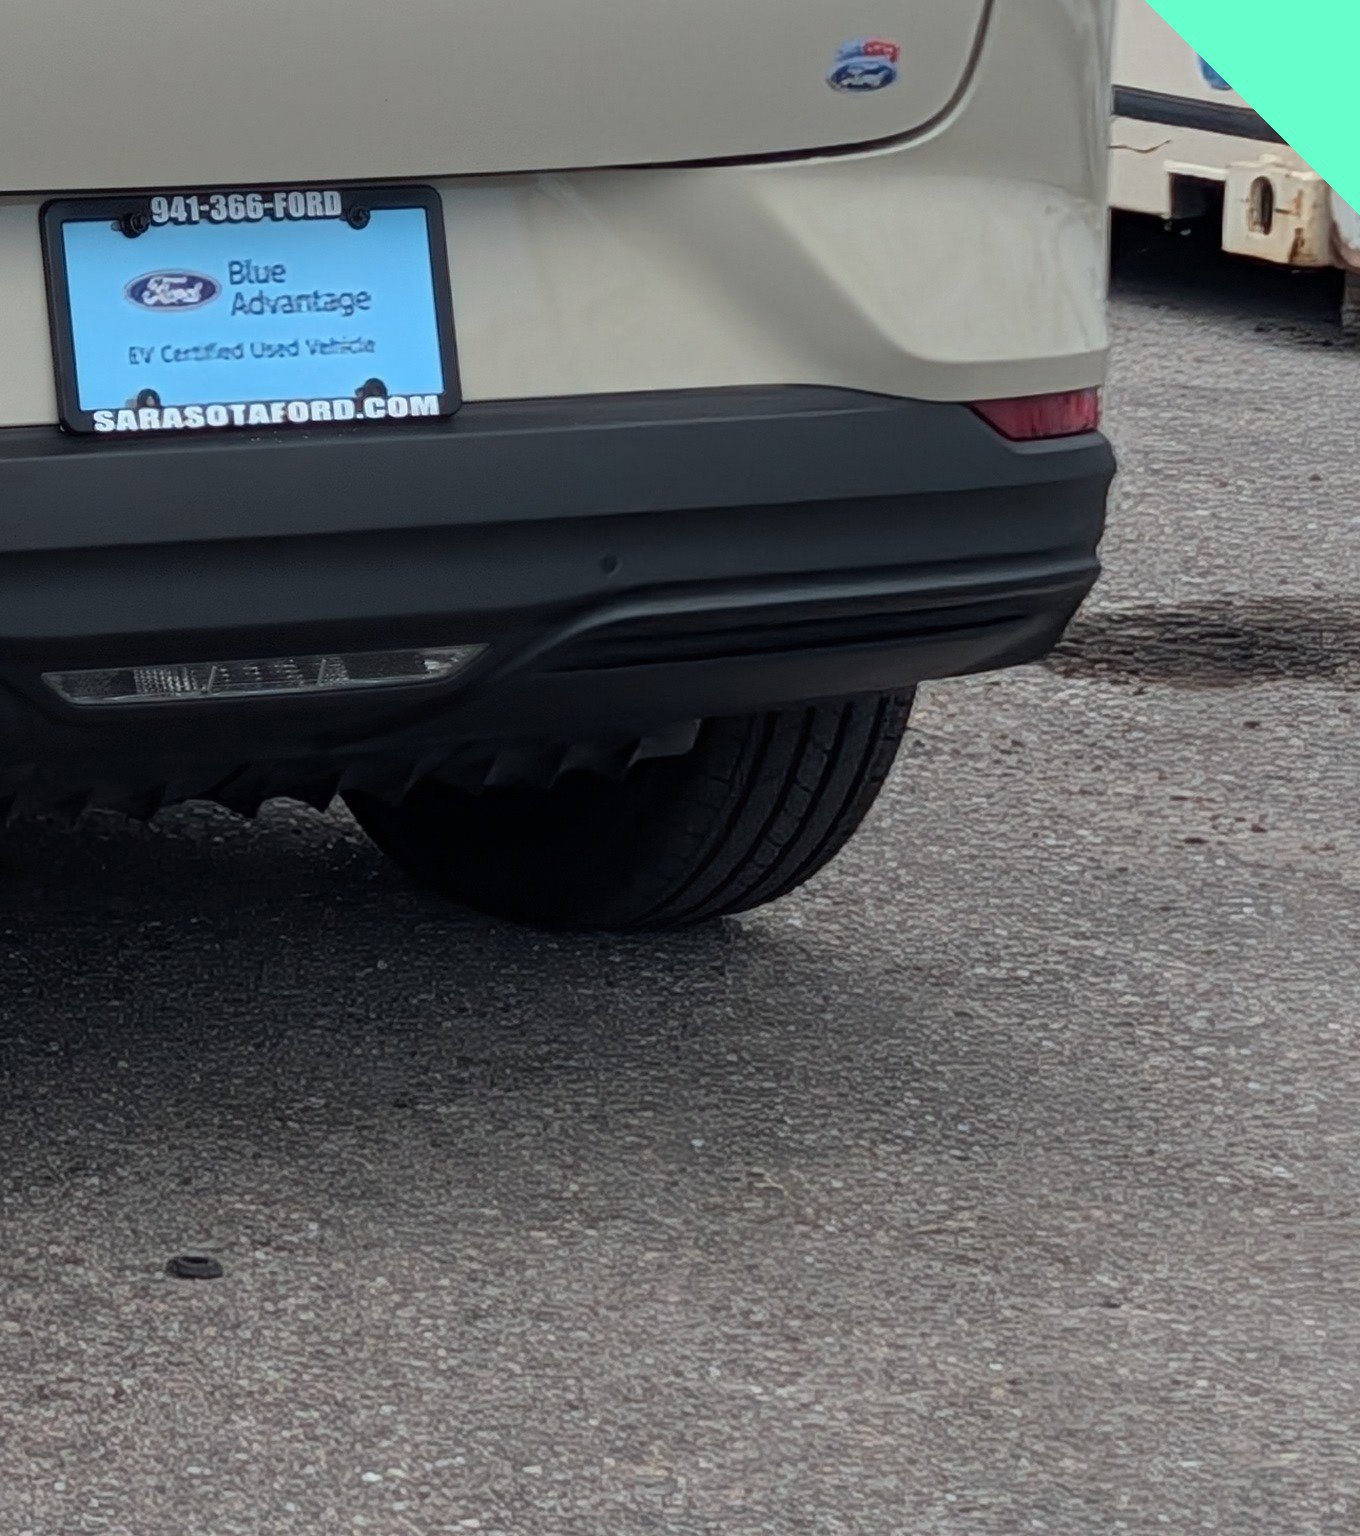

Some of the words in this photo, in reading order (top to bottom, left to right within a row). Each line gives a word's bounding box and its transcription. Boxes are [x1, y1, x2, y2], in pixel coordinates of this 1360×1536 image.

[149, 191, 342, 224] 941-366-FORD
[228, 259, 287, 285] Blue
[230, 289, 371, 317] Advantage
[129, 345, 154, 365] EV
[250, 340, 299, 359] Used
[93, 395, 441, 433] SARASOTAFORD.COM
